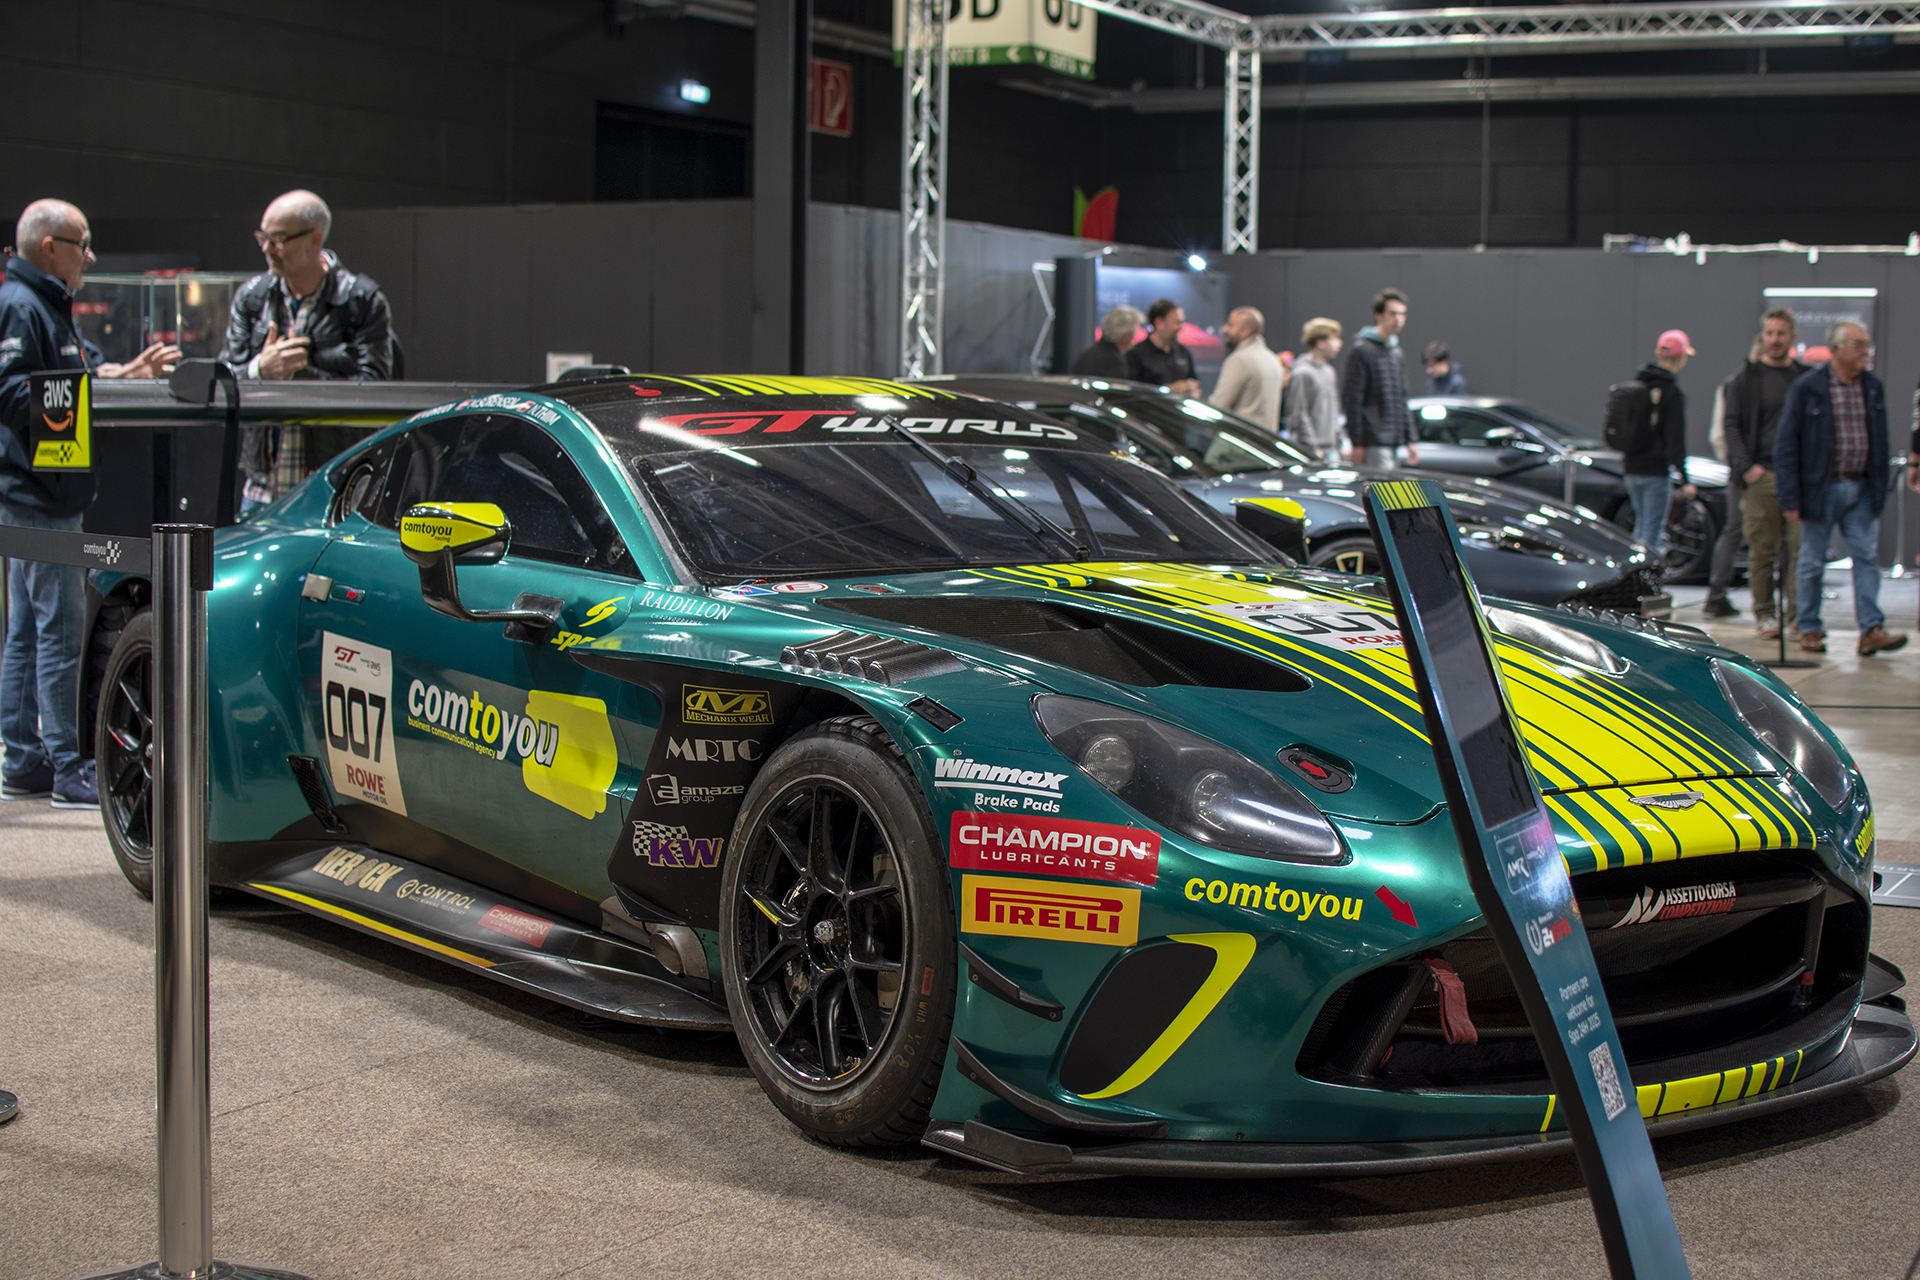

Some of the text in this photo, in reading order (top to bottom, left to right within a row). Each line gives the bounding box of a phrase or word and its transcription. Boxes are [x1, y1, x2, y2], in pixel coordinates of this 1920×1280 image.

[43, 378, 73, 409] aws
[639, 410, 1079, 441] GT WORLD
[403, 521, 453, 537] comtoyou
[639, 590, 735, 622] RAIDILLON
[1337, 634, 1404, 646] ROW
[326, 680, 387, 764] 007
[408, 679, 559, 767] comtoyou
[686, 709, 770, 723] MECHANIX WEAR
[407, 715, 497, 760] business communication agency
[666, 736, 763, 763] MRTC
[345, 763, 386, 796] ROWE
[681, 785, 745, 796] amaze
[681, 794, 716, 804] group
[974, 792, 1061, 813] Brake Pads
[648, 837, 725, 868] KW
[980, 850, 1116, 871] LUBRICANTS
[415, 883, 476, 910] CONTROL
[1184, 877, 1364, 922] comtoyou
[1665, 881, 1737, 906] ASSETTO CORSA
[489, 908, 550, 936] CHAMPION
[975, 887, 1124, 934] PIRELLI
[1659, 898, 1737, 921] COMPETIZIONE
[1566, 994, 1595, 1021] welcome for
[1567, 1028, 1581, 1047] Spa
